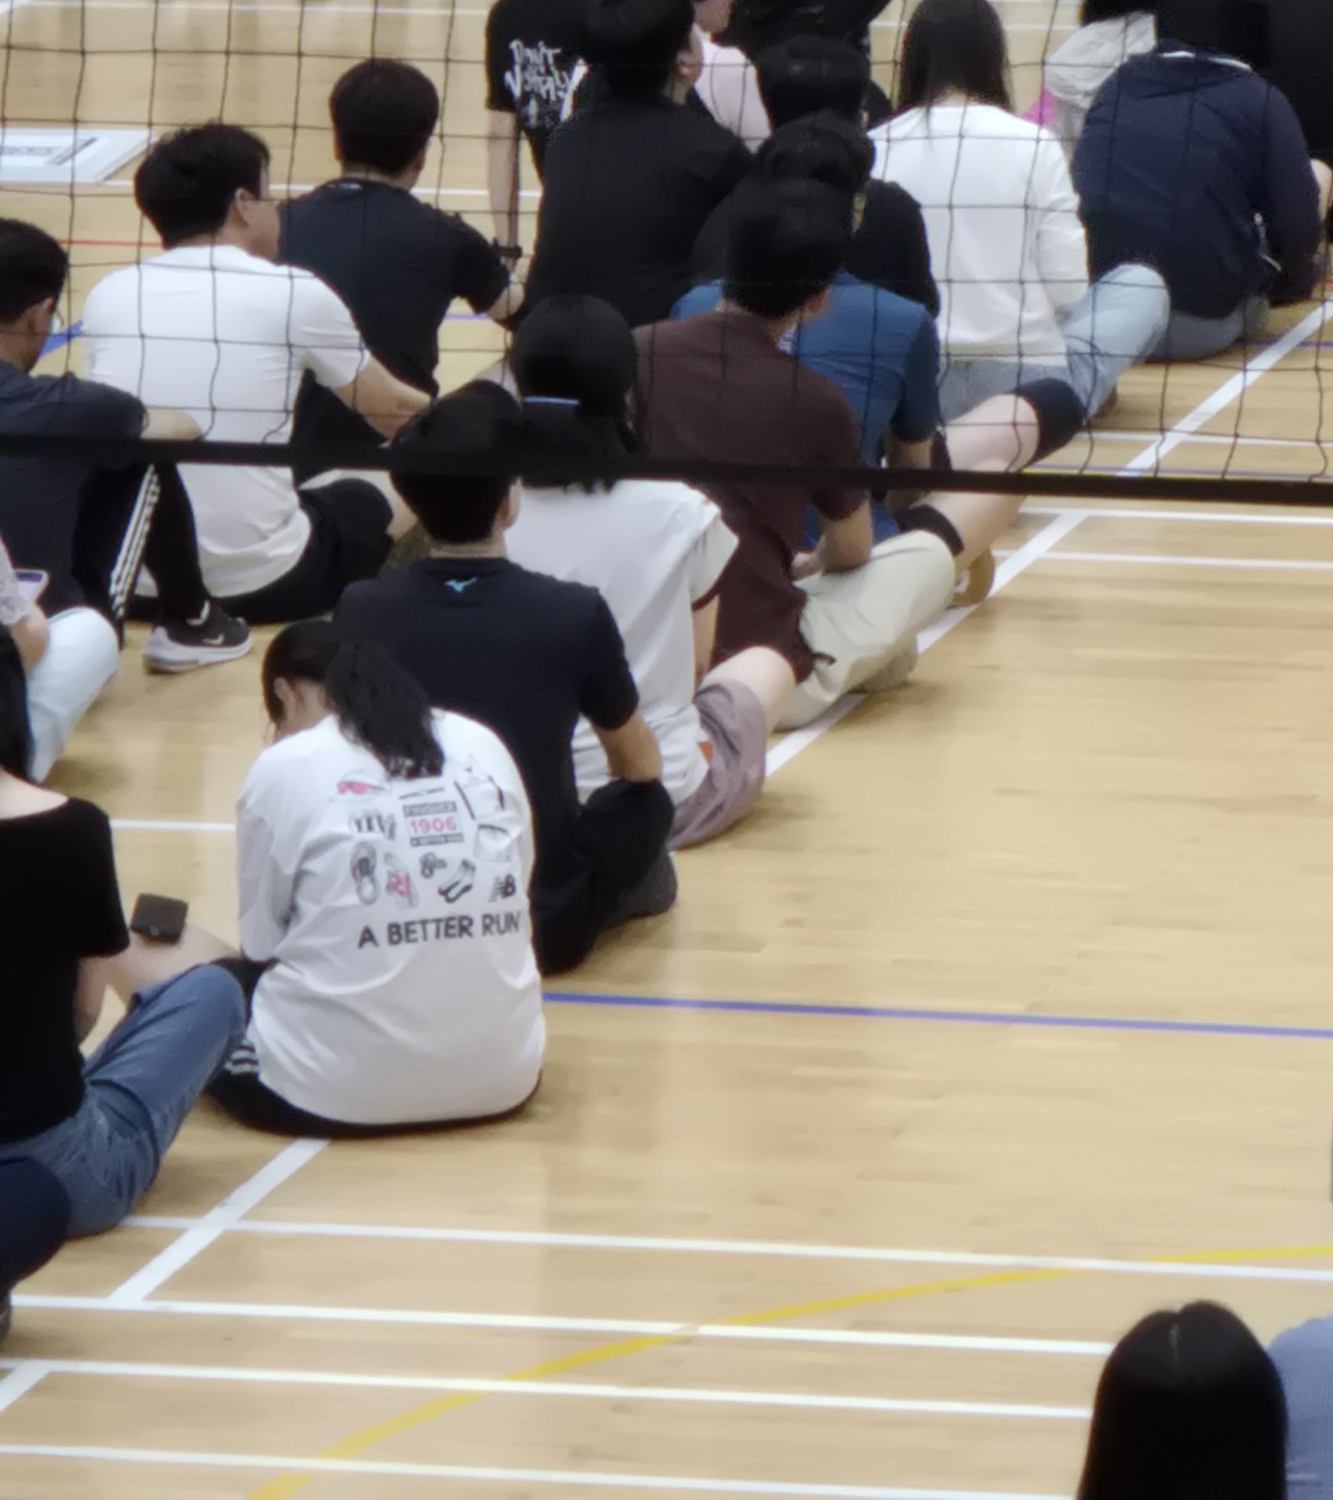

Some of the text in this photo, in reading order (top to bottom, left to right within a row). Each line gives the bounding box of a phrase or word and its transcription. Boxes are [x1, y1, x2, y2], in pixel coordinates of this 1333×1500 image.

[411, 816, 457, 834] 1906
[357, 911, 522, 949] A BETTER RUN
